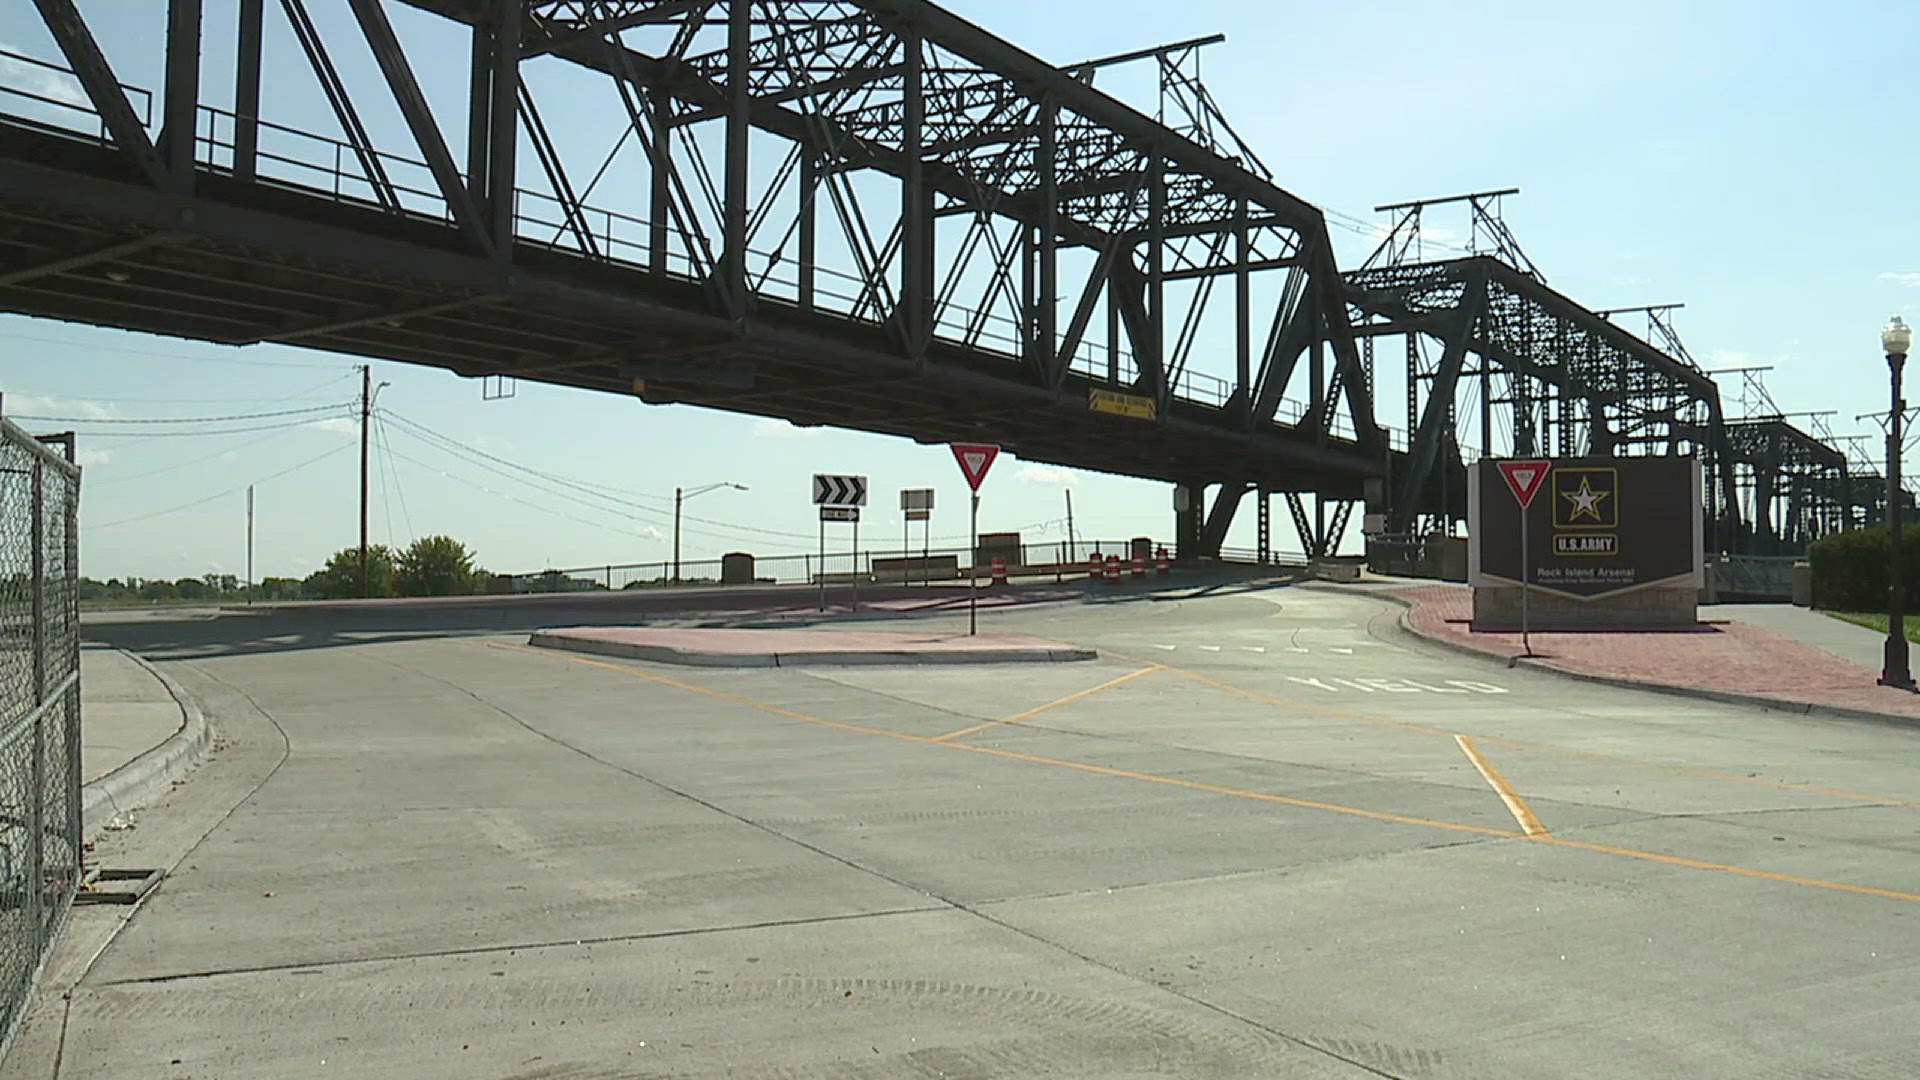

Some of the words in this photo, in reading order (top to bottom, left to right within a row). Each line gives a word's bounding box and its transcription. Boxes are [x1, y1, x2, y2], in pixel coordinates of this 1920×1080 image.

[1536, 567, 1562, 577] Rock
[1564, 567, 1595, 577] Island
[1597, 567, 1635, 577] Arsenal
[1287, 676, 1509, 694] YIELD
